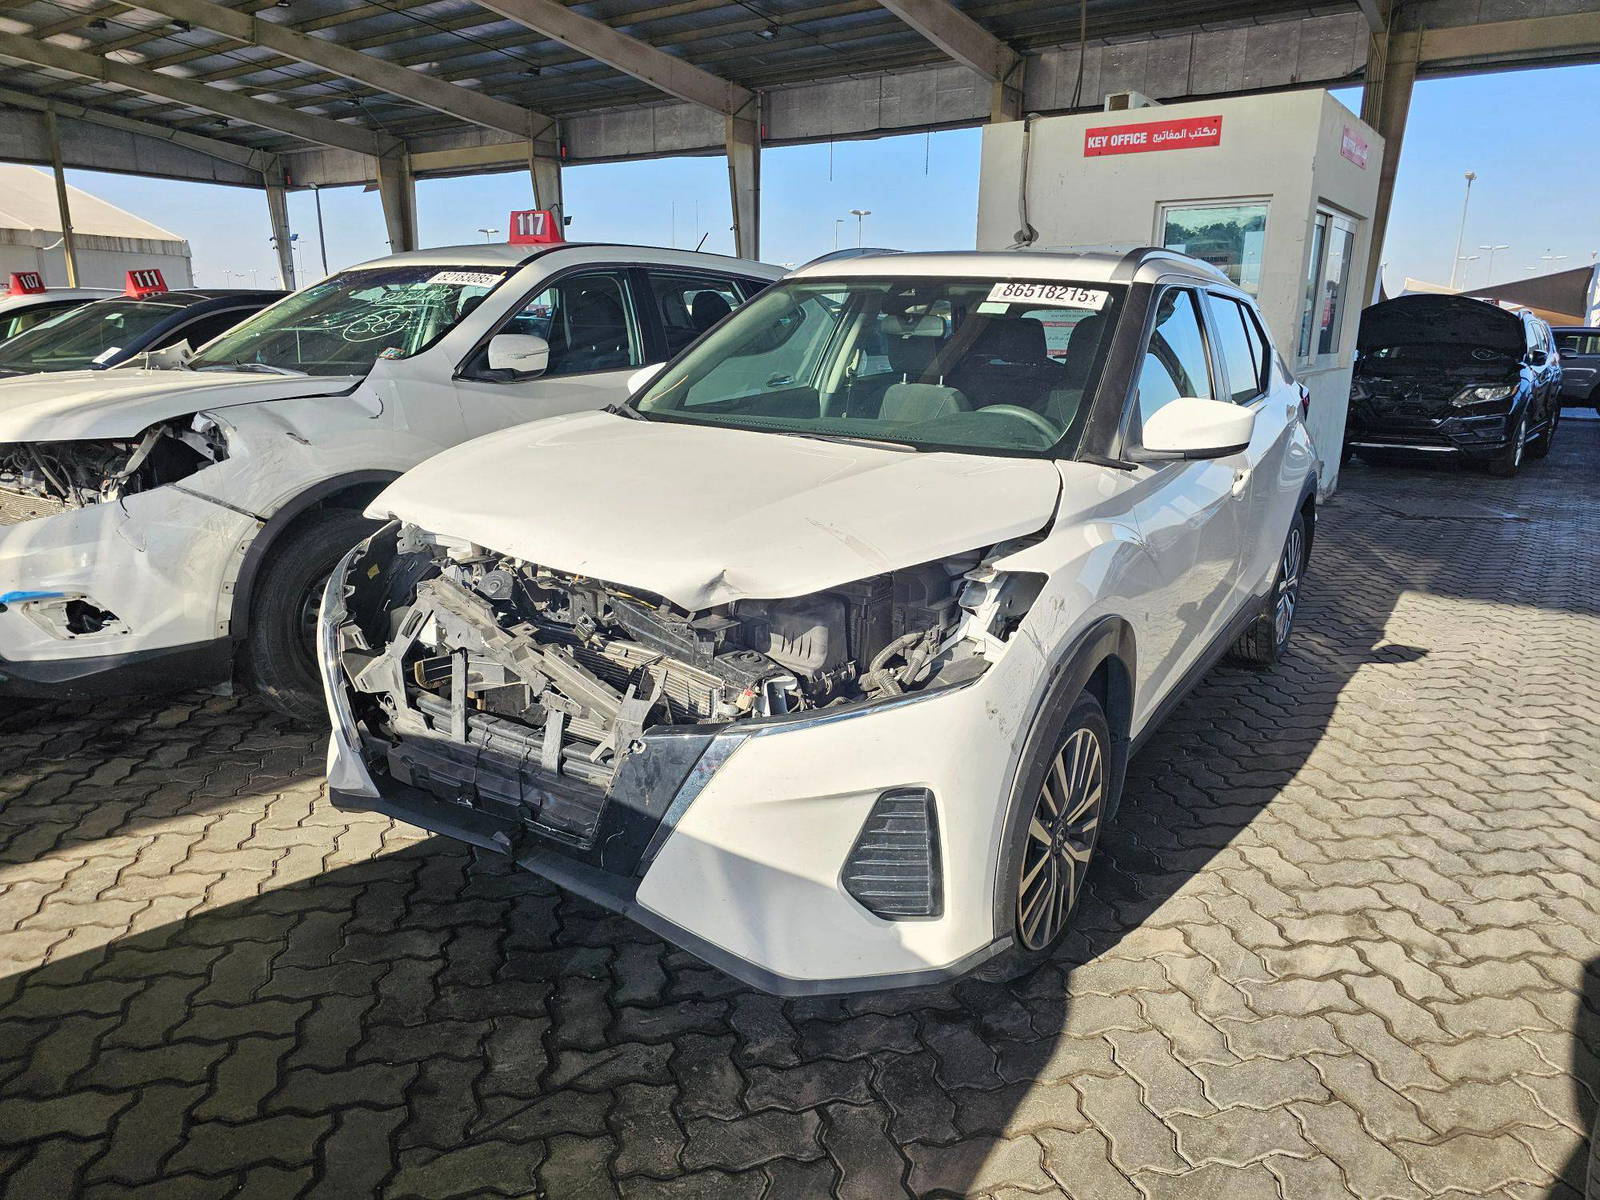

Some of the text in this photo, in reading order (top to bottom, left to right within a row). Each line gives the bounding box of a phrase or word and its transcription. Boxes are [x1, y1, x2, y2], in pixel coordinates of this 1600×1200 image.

[1087, 132, 1147, 148] KEY OFFICE
[1152, 126, 1217, 143] مكتب المفاتيح
[518, 213, 544, 235] 117
[20, 273, 39, 289] 107
[134, 270, 159, 288] 111
